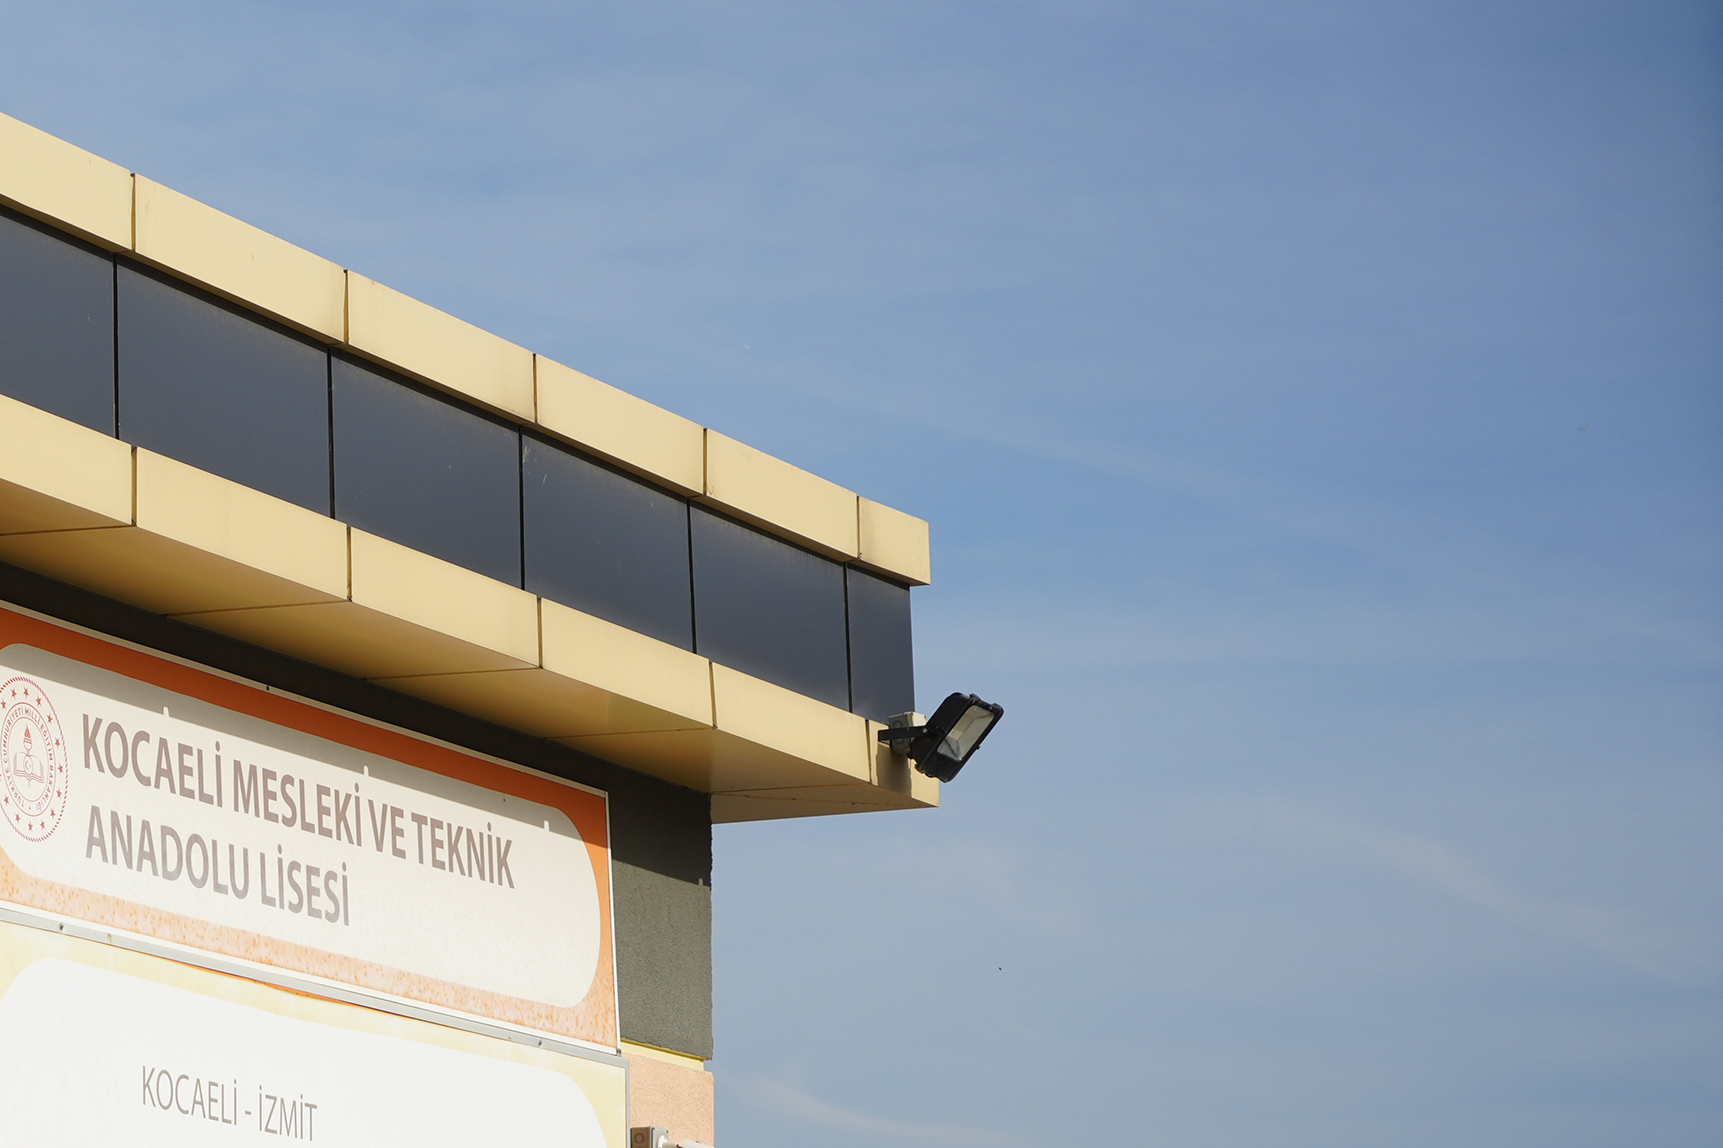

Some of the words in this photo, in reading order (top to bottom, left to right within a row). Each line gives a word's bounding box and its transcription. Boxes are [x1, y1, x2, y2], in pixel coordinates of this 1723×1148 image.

[3, 707, 24, 764] CUMHURİYETİ
[24, 708, 41, 724] MİLLİ
[82, 713, 223, 807] KOCAELİ
[233, 759, 363, 848] MESLEKİ
[368, 801, 407, 860] VE
[411, 813, 515, 890] TEKNİK
[85, 805, 252, 900] ANADOLU
[260, 850, 350, 927] LİSESİ
[142, 1064, 237, 1126] KOCAELİ
[258, 1085, 318, 1142] İZMİT
